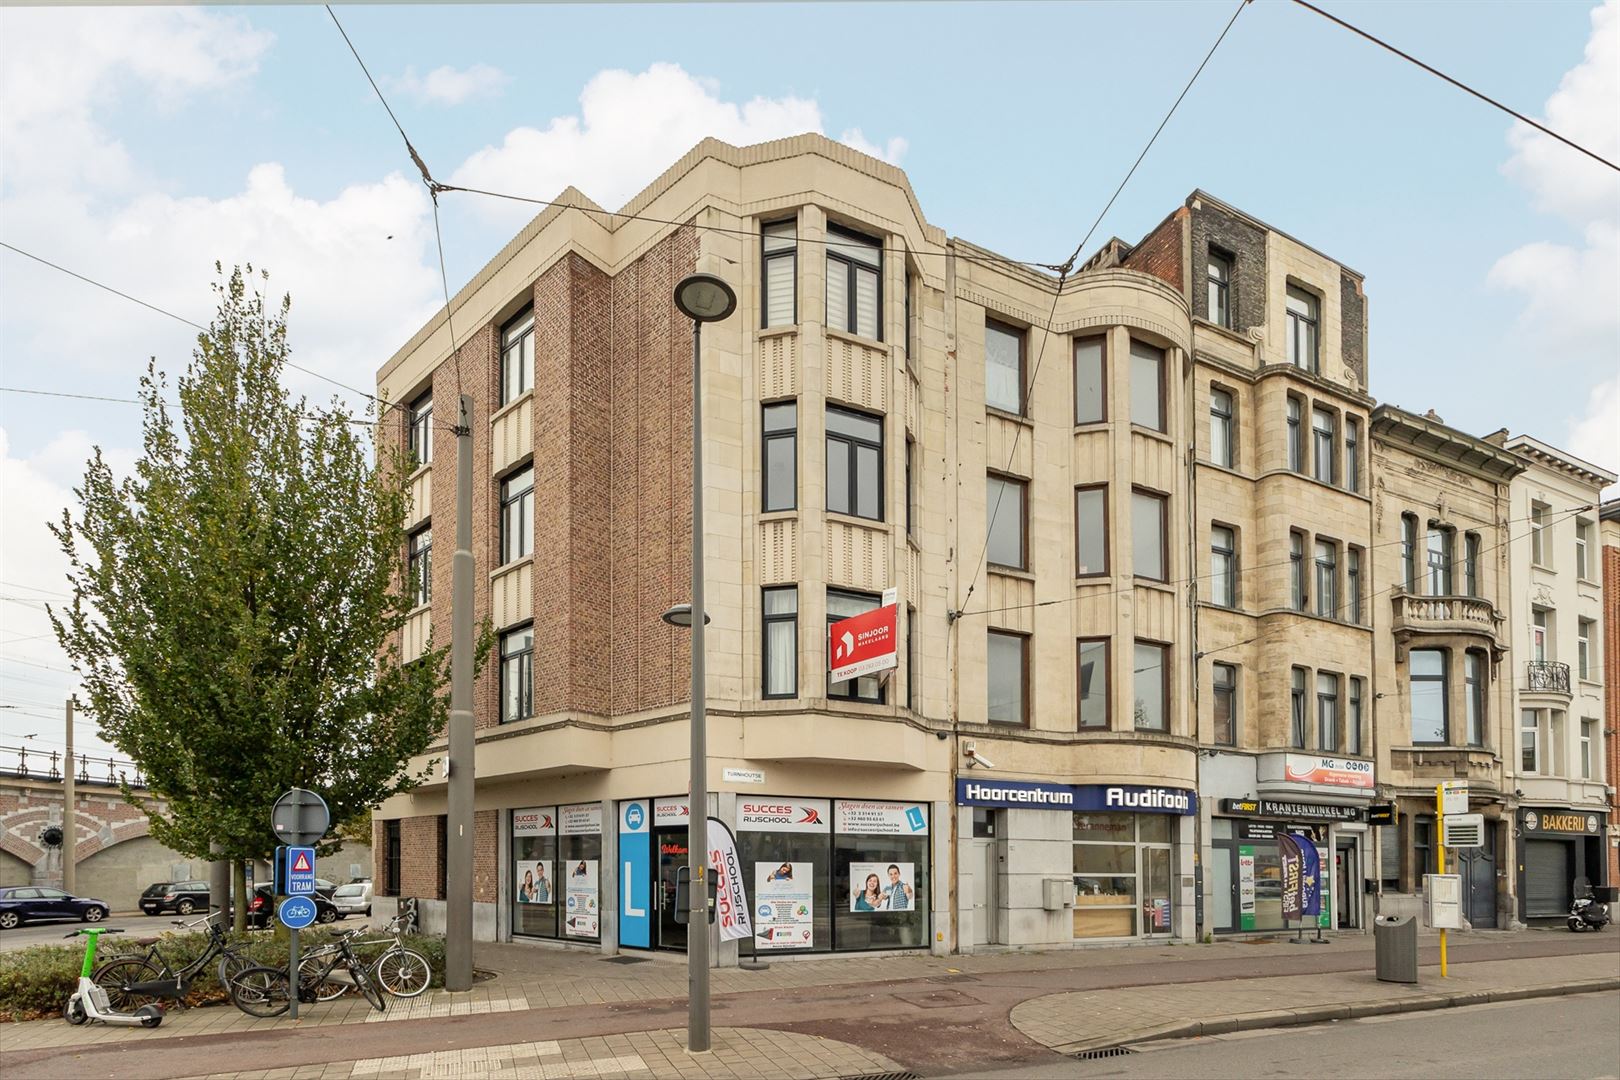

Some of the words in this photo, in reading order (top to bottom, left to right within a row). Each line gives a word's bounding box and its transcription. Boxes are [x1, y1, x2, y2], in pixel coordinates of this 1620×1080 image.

[858, 626, 888, 641] SINJOOR
[1322, 759, 1334, 768] MG
[966, 784, 1073, 804] Hoorcentrum
[1106, 788, 1188, 810] Audifoon
[744, 804, 792, 814] SUCCES
[1232, 802, 1257, 811] betFIRST
[1265, 802, 1340, 815] KRANTENWINKEL
[1344, 808, 1356, 816] MG
[910, 812, 922, 827] L
[1542, 814, 1584, 831] BAKKERIJ
[292, 882, 312, 891] TRAM
[624, 862, 645, 917] L
[712, 850, 732, 928] SUCCES
[726, 847, 746, 924] RIJSCHOOL
